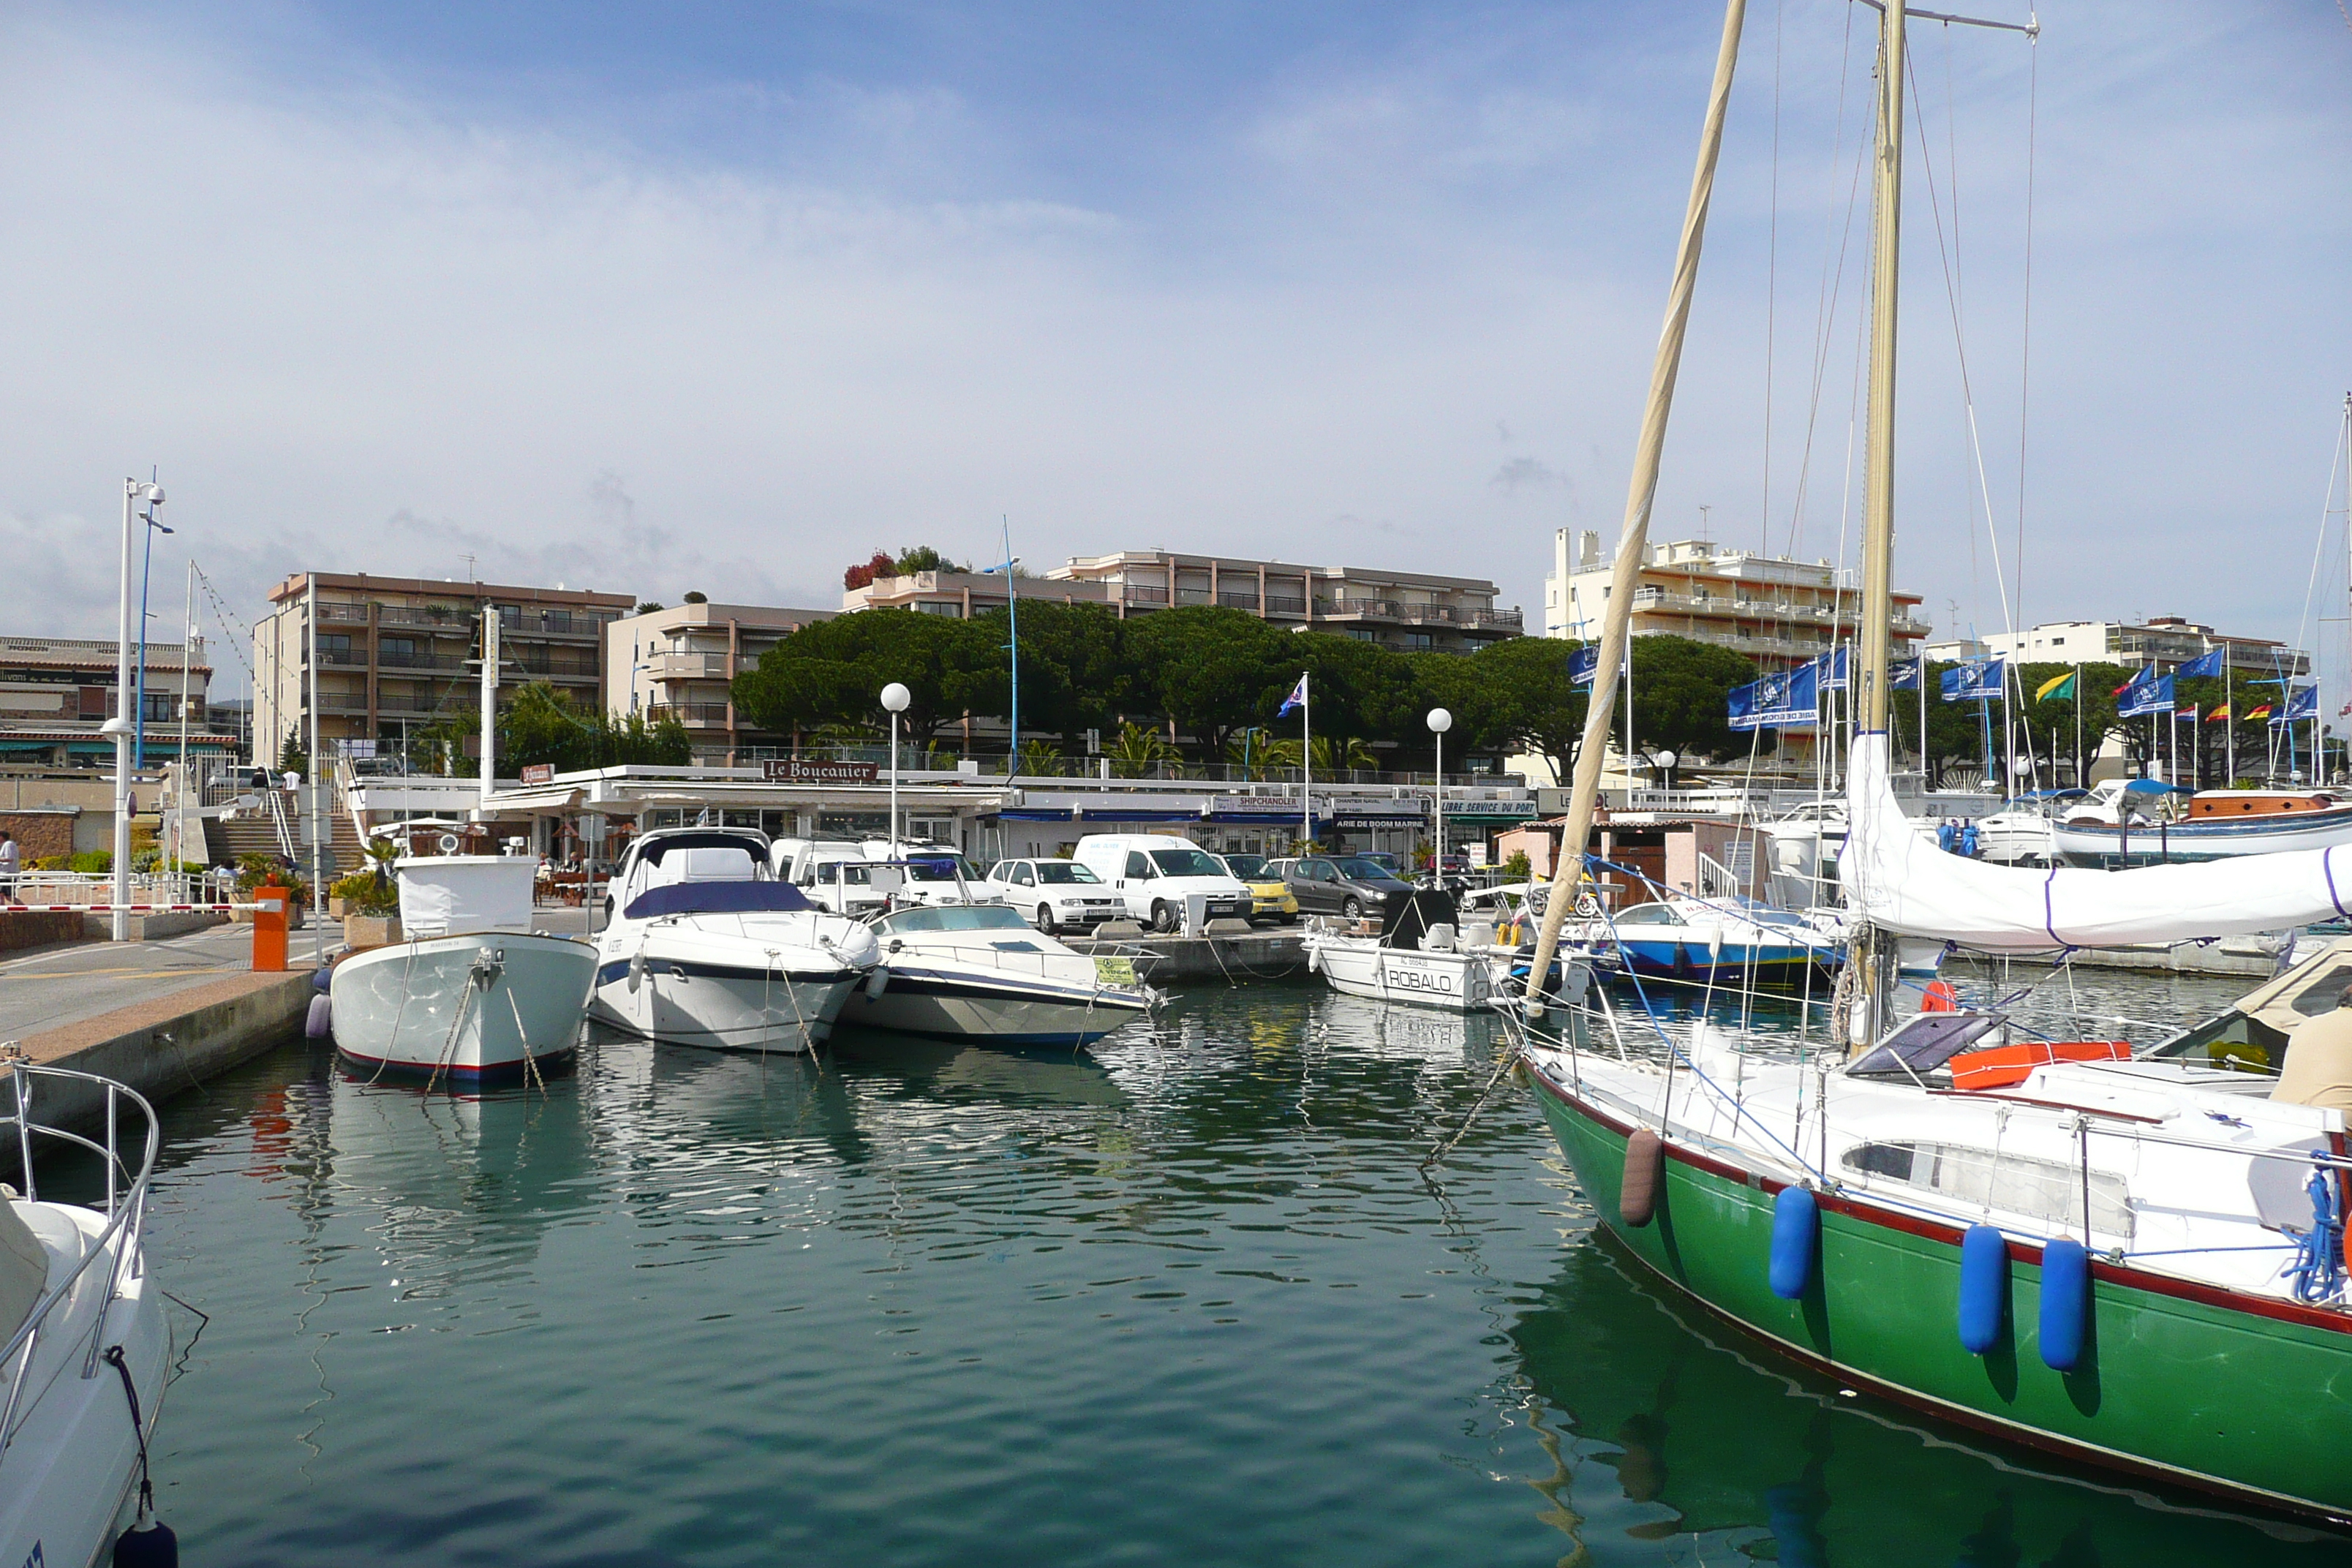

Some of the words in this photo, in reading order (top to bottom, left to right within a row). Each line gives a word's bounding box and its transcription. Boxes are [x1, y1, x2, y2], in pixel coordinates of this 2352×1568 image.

[769, 761, 785, 776] Le
[790, 762, 870, 777] Boucanier
[1240, 797, 1297, 805] SHIPCHANDLER
[1441, 802, 1463, 812] LIBRE
[1466, 802, 1498, 812] SERVICE
[1501, 803, 1512, 812] DU
[1515, 804, 1535, 813] PORT
[1390, 970, 1451, 992] ROBALO
